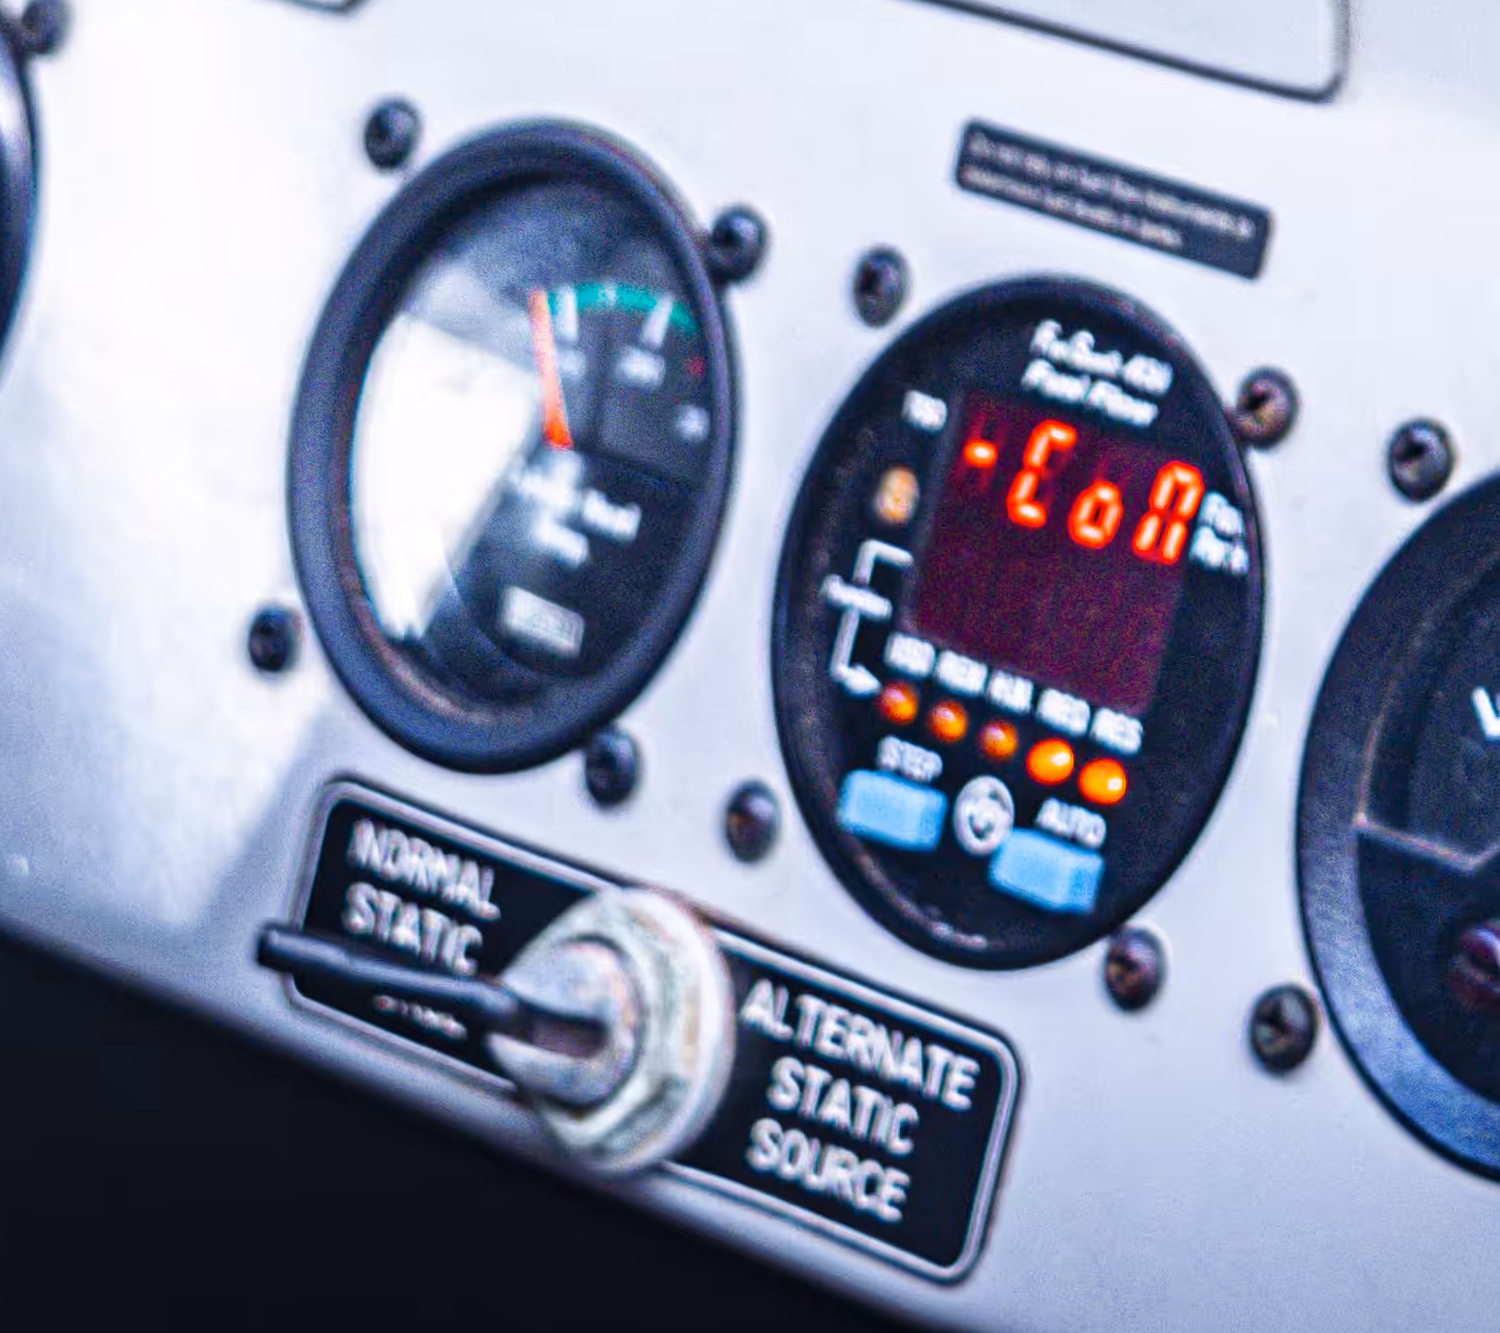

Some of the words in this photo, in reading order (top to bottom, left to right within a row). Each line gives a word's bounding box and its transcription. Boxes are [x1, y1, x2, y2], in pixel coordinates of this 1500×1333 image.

[346, 818, 501, 924] NORMAL
[1035, 795, 1108, 849] AUTO
[340, 880, 485, 977] STATIC
[740, 978, 983, 1111] ALTERNATE
[766, 1056, 920, 1156] STATIC
[746, 1117, 911, 1223] SOURCE
